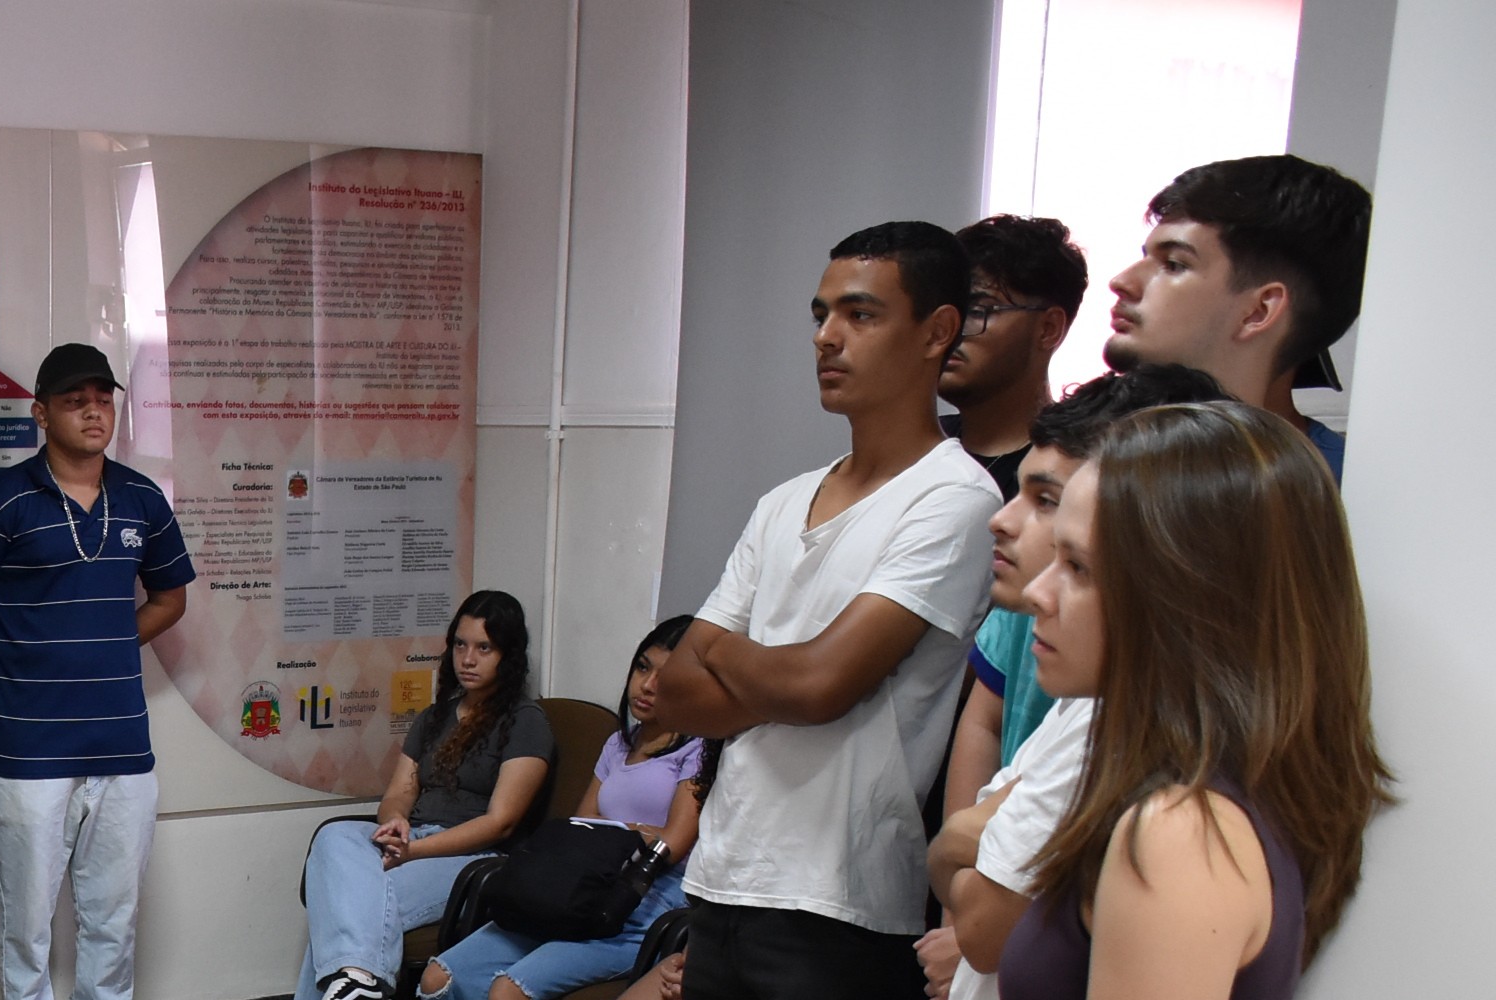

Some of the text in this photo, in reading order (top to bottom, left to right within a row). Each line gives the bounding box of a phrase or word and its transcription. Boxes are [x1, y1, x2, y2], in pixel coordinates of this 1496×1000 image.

[308, 182, 346, 194] Instituto
[348, 184, 361, 194] do
[364, 185, 411, 198] Legislativo
[414, 188, 442, 198] Ituano
[359, 198, 465, 212] Resolução 236/2013
[143, 400, 184, 410] Contribua,
[186, 401, 223, 409] enviando
[225, 400, 247, 410] fotos,
[249, 400, 297, 410] documentos,
[344, 402, 379, 411] sugestões
[382, 403, 394, 411] que
[397, 403, 424, 411] possam
[426, 402, 460, 410] colaborar
[240, 412, 281, 420] exposição,
[283, 412, 311, 420] através
[221, 462, 274, 471] Ficha Técnica:
[232, 483, 273, 491] Curadoria:
[210, 581, 239, 591] Direção
[240, 580, 251, 589] de
[406, 654, 440, 663] Colabora
[276, 659, 317, 670] Realização
[340, 688, 380, 700] Instituto do
[339, 704, 376, 715] Legislativo
[339, 720, 362, 728] Ituano
